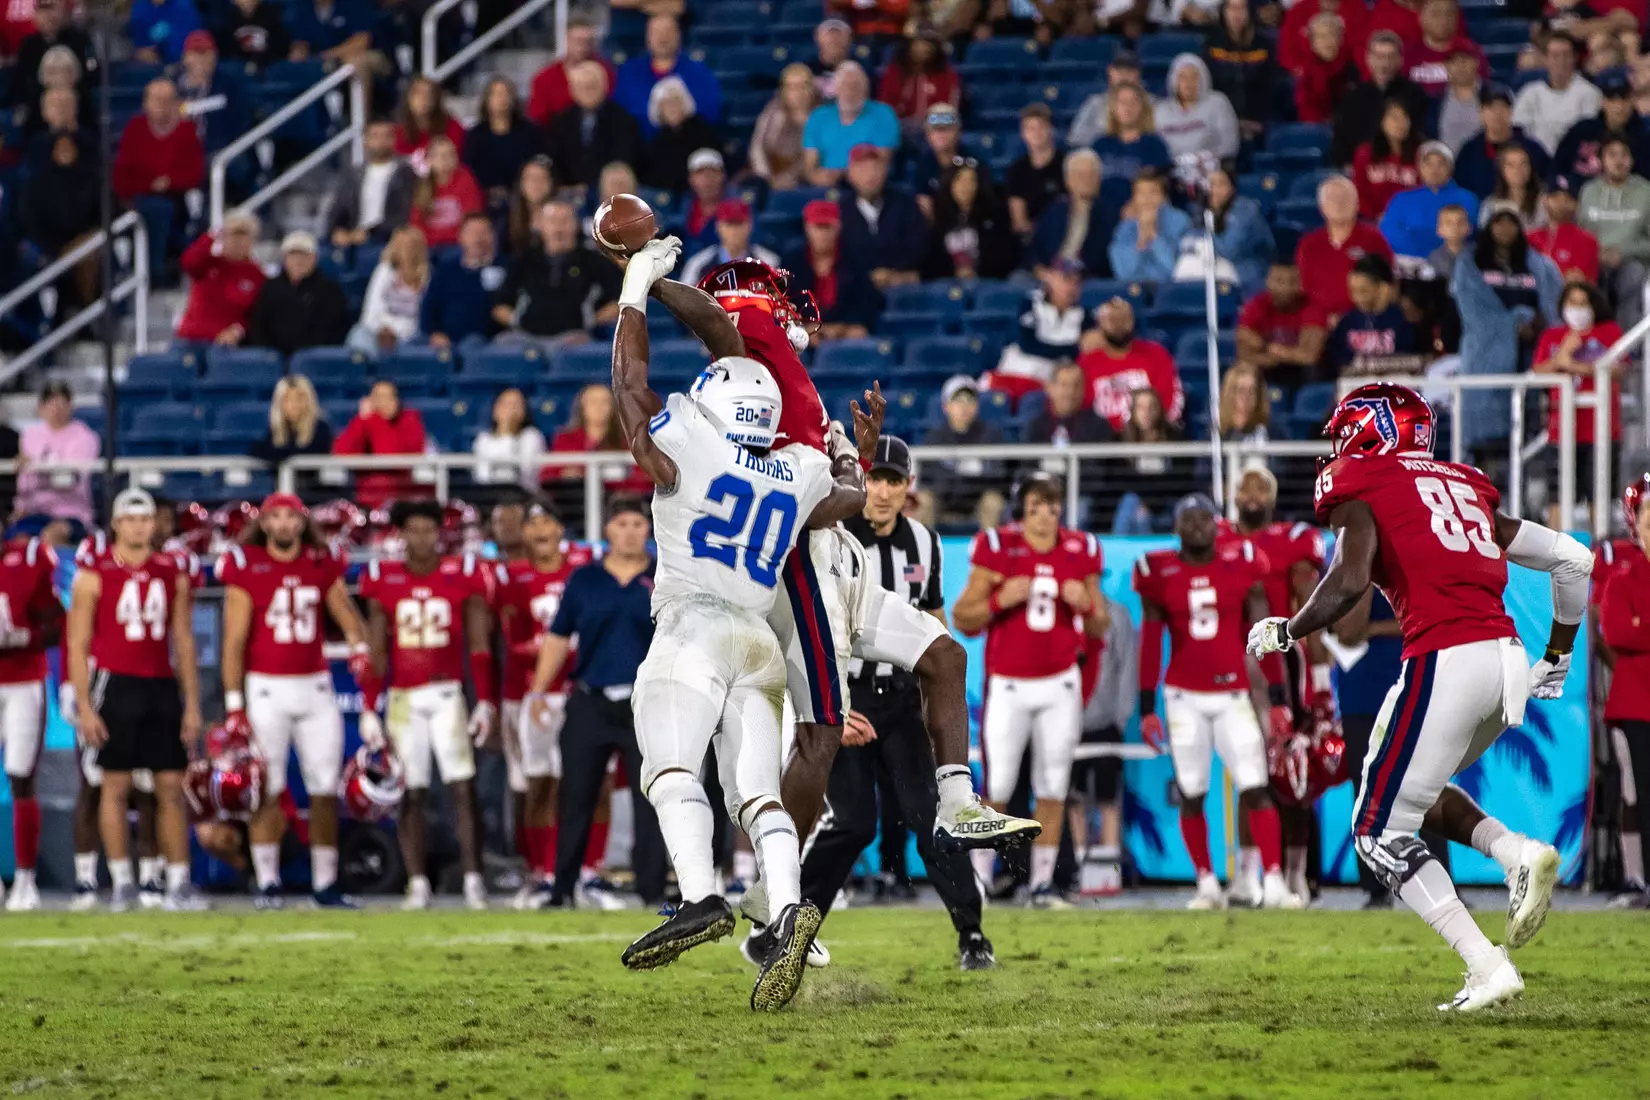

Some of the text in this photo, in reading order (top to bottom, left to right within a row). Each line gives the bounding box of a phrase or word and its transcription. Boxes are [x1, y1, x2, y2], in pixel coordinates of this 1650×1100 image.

[716, 267, 738, 291] 7
[735, 406, 754, 423] 20
[726, 432, 745, 442] BLUE
[734, 445, 794, 482] THOMAS
[1315, 468, 1334, 502] 85
[687, 472, 798, 591] 20
[1414, 476, 1501, 560] 85
[116, 577, 168, 642] 44
[265, 586, 321, 644] 45
[395, 598, 451, 649] 22
[1187, 586, 1219, 641] 5
[951, 819, 1007, 834] ADIZERO
